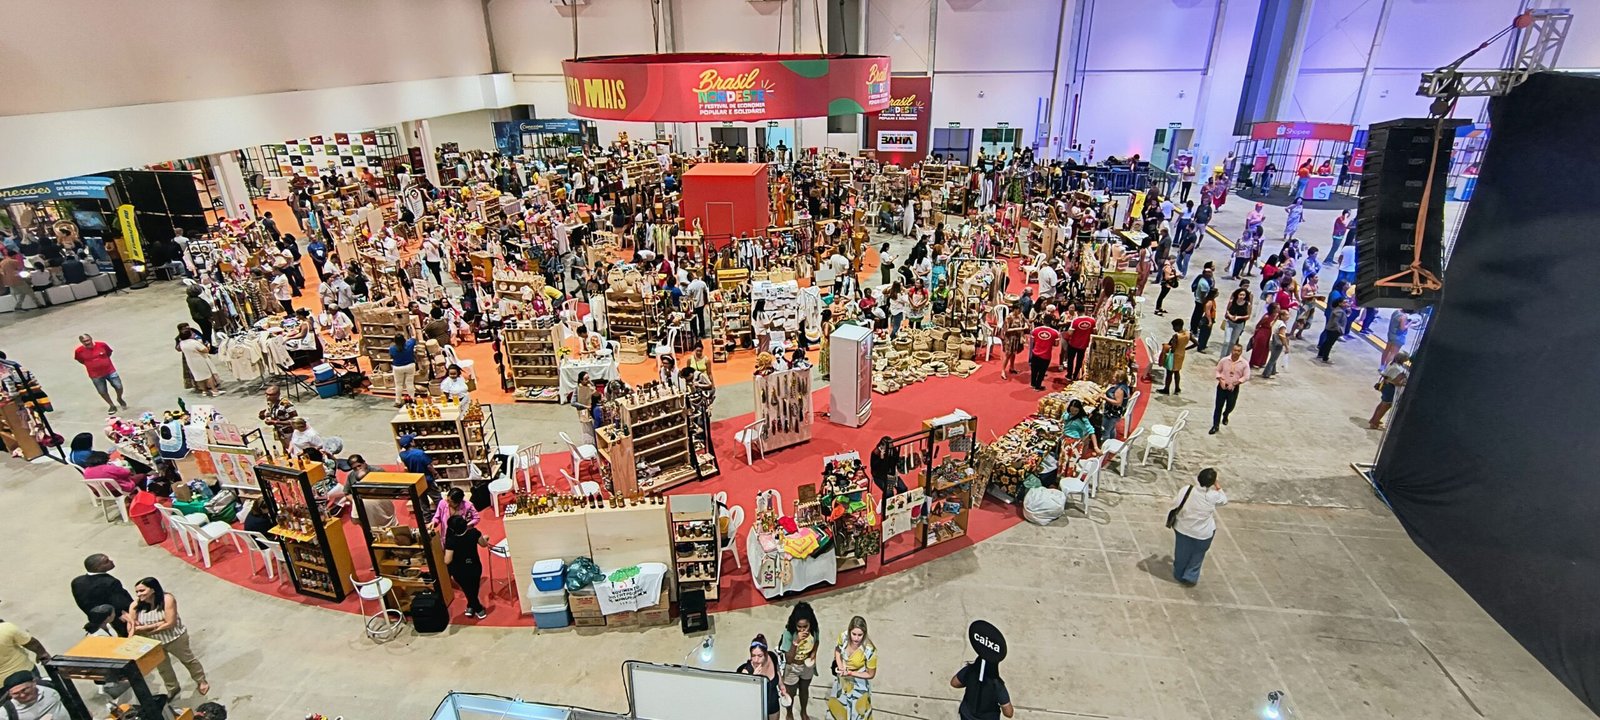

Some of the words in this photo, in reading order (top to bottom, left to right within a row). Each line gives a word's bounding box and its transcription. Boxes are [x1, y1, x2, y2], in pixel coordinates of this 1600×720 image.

[692, 68, 760, 92] Brasil
[584, 79, 627, 109] MAIS
[698, 90, 765, 103] NORDESTE
[889, 94, 916, 107] rasil
[881, 106, 918, 114] ORDESTE
[881, 136, 913, 145] BAHIA
[974, 632, 1001, 654] caixa
